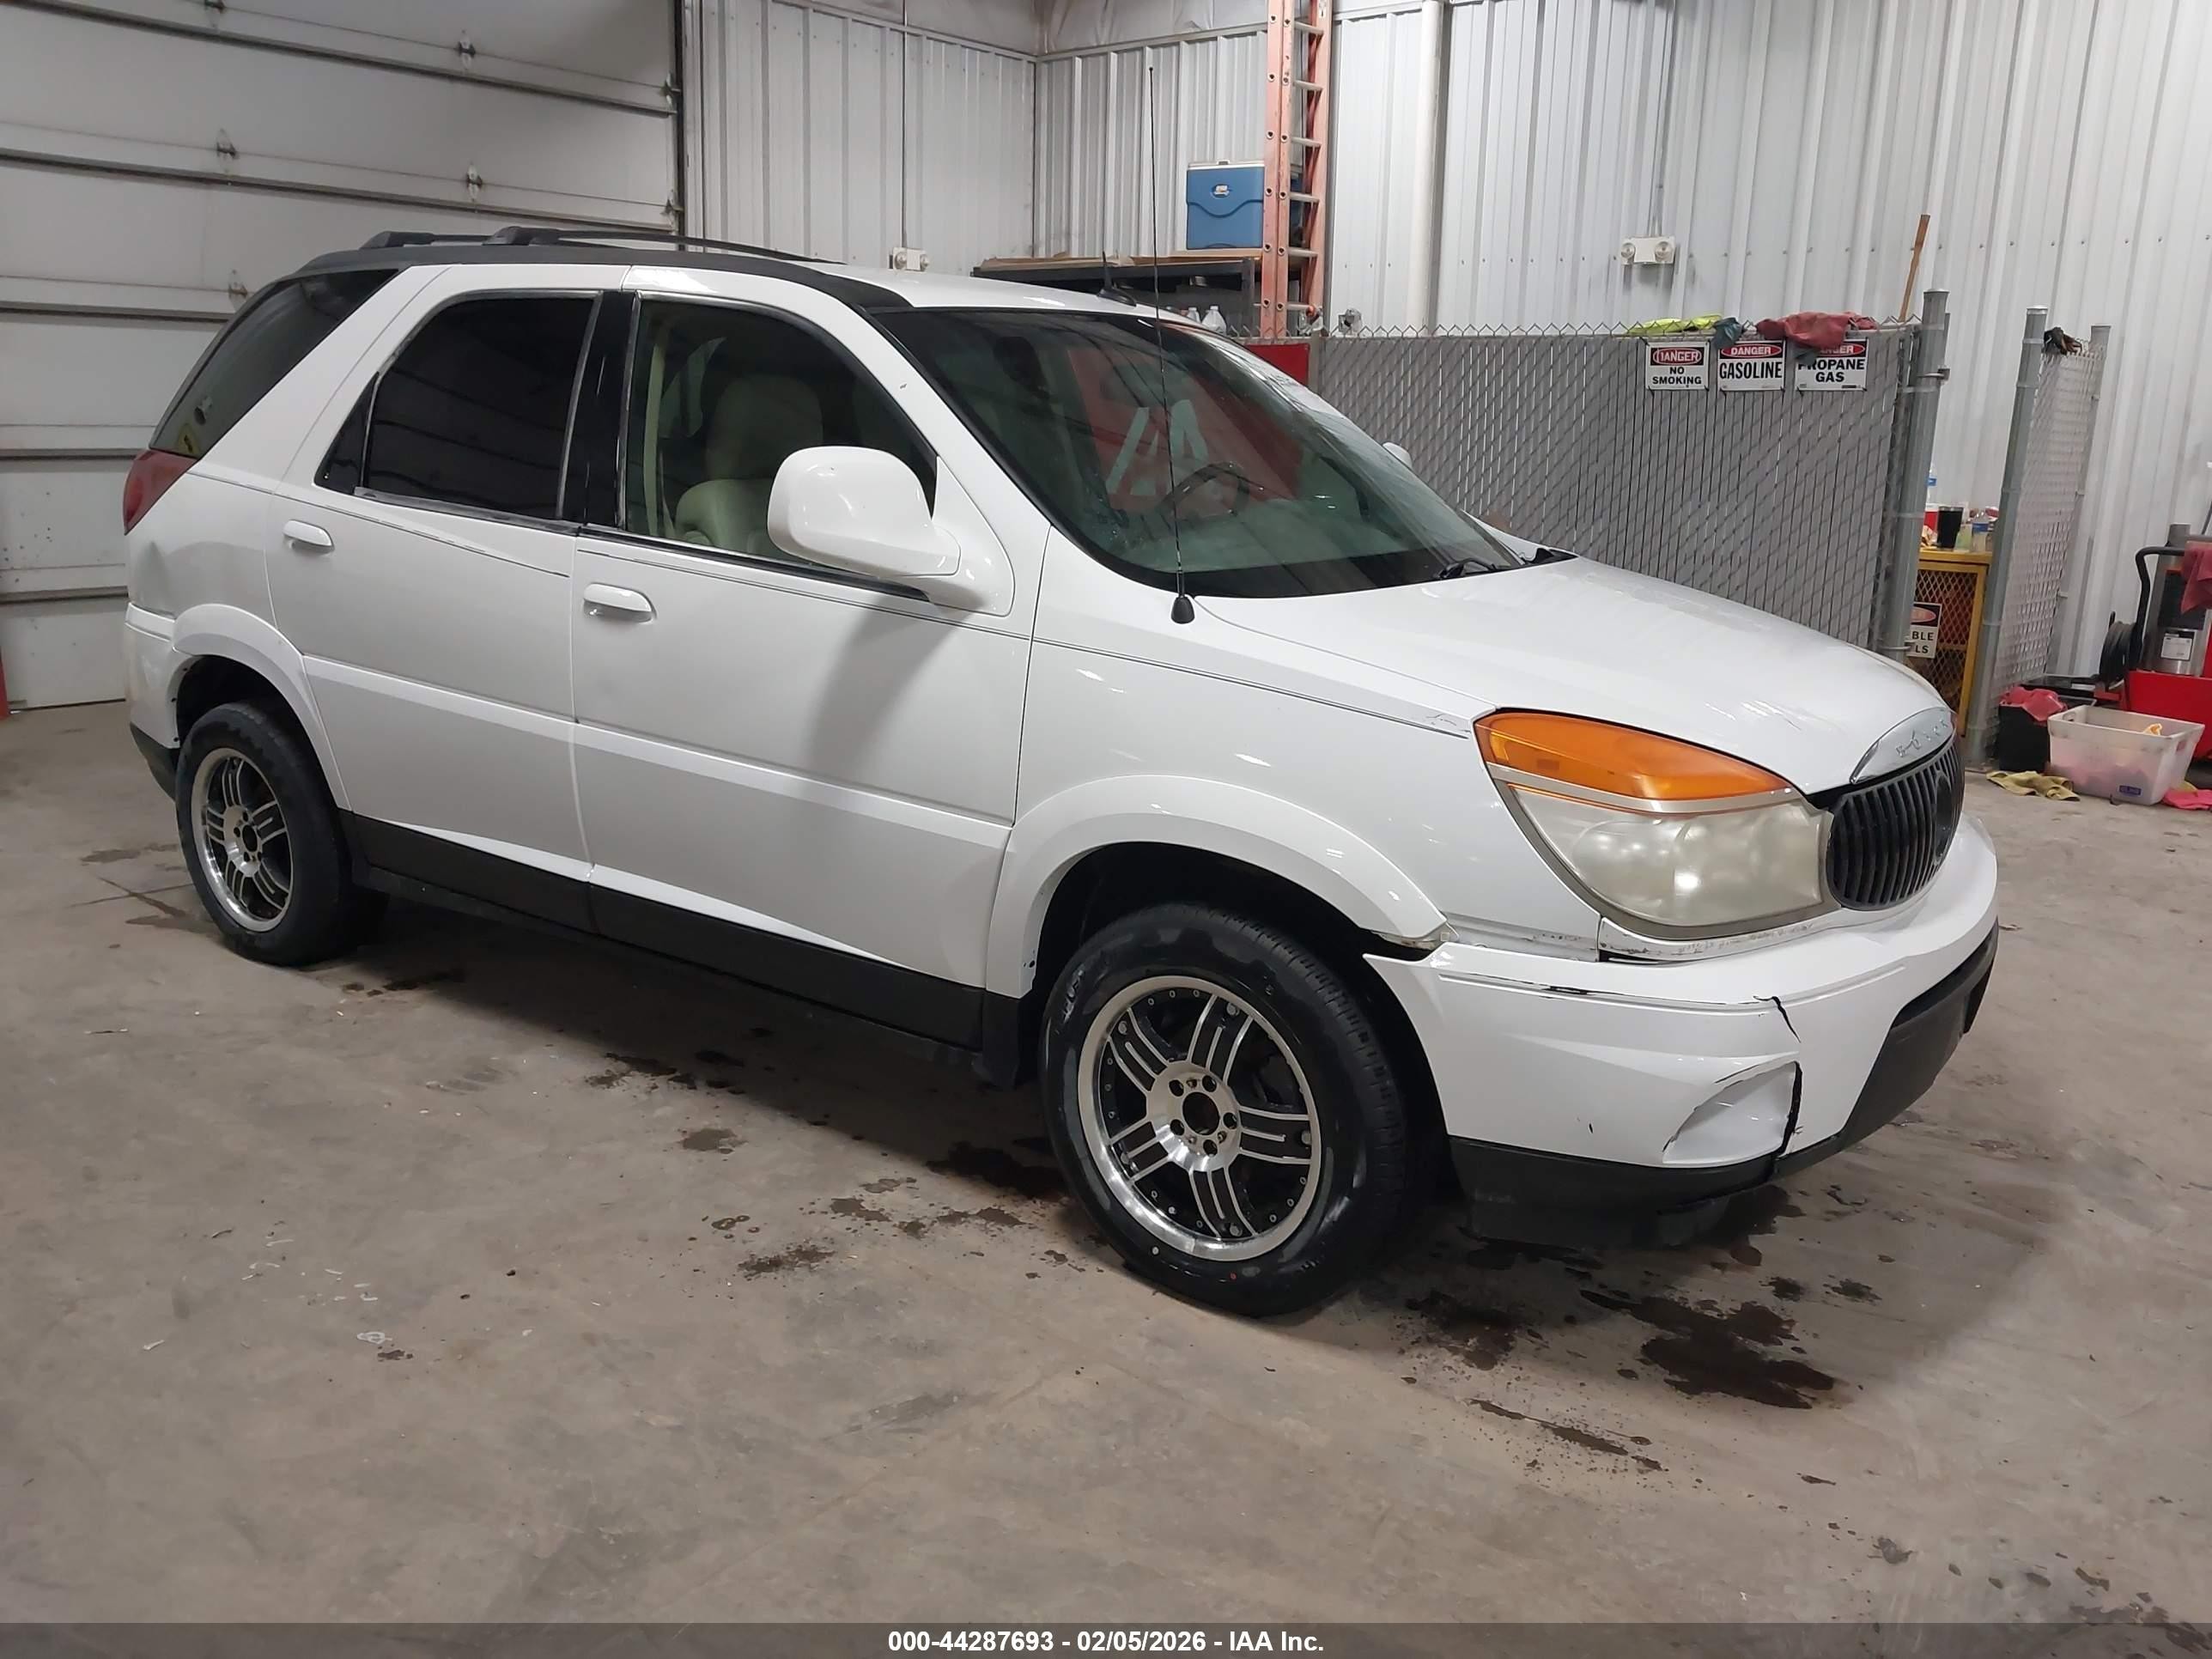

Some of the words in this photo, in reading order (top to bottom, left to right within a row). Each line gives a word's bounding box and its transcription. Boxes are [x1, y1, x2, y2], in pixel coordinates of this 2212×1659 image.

[1730, 346, 1771, 356] DANGER
[1719, 362, 1783, 379] GASOLINE
[1652, 376, 1702, 385] SMOKING
[1815, 372, 1845, 382] GAS
